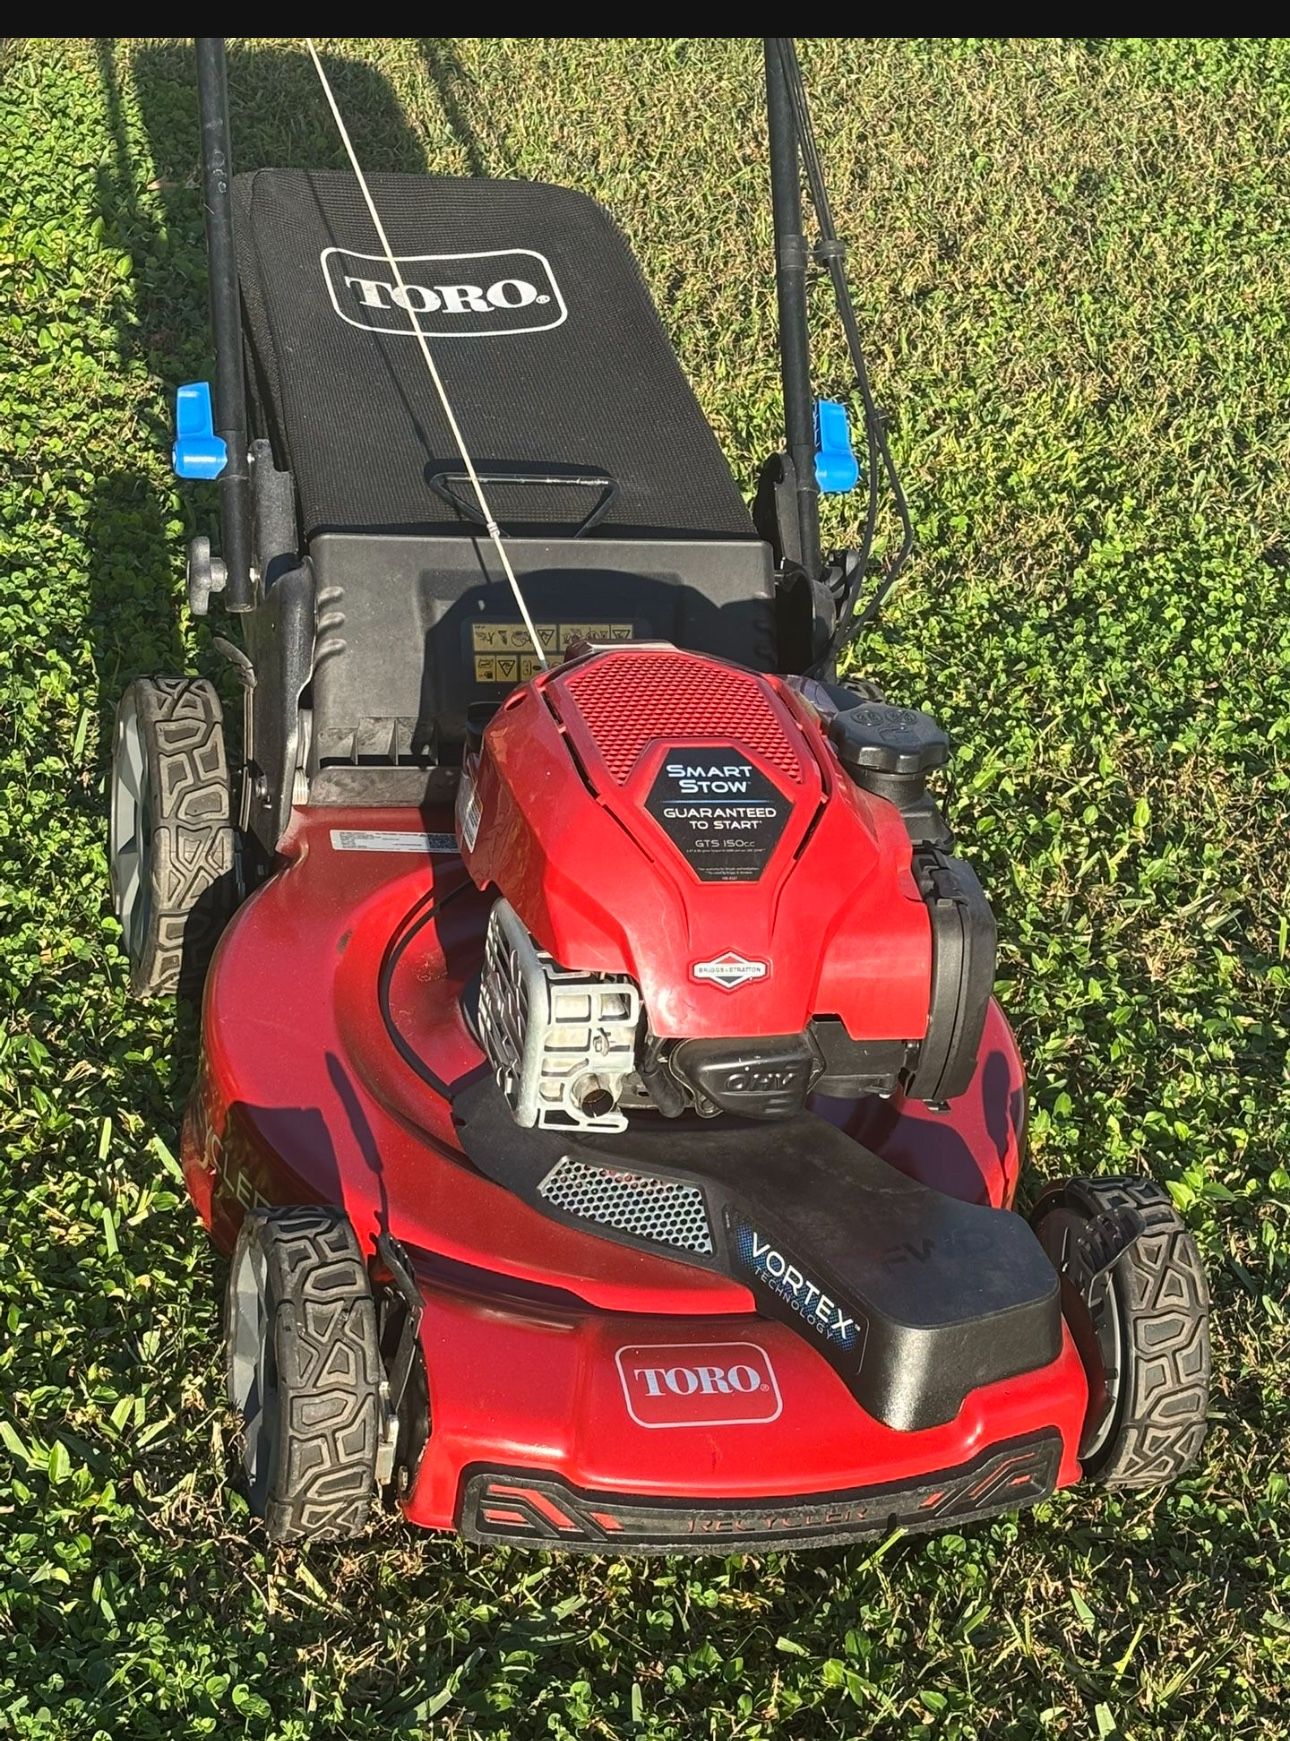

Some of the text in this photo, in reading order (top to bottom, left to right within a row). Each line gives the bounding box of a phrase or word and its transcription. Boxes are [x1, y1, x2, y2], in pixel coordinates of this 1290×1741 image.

[666, 764, 753, 778] SMART
[663, 807, 777, 819] GUARANTEED
[689, 820, 708, 830] TO
[695, 839, 719, 848] GTS
[725, 1072, 796, 1091] OHV
[754, 1266, 834, 1340] TECHNOLOGY
[687, 1507, 868, 1534] RECYCLER
